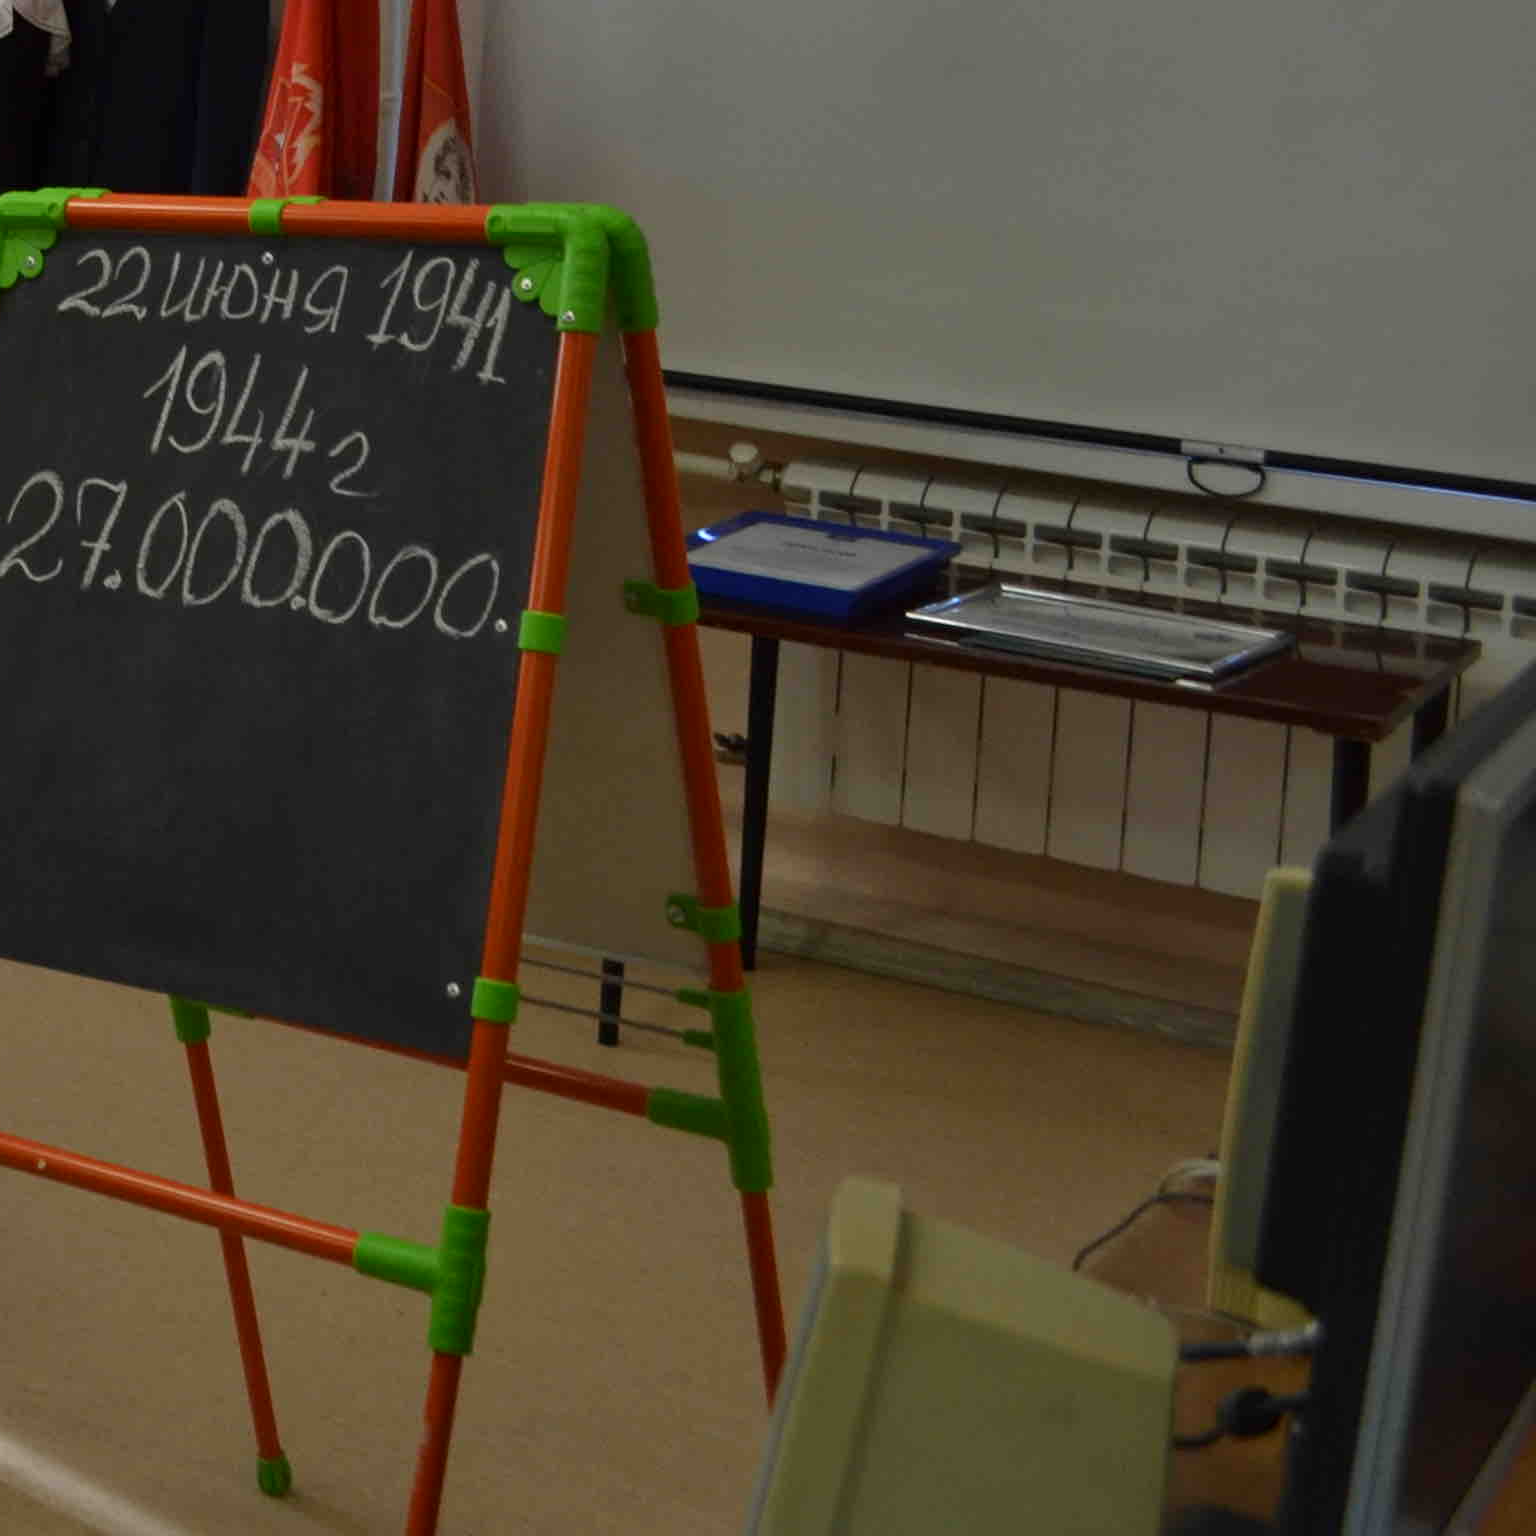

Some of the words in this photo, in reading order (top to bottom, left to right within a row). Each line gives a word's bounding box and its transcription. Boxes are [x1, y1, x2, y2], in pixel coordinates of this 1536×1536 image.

[58, 246, 152, 321] 22
[365, 249, 512, 385] 1941
[143, 345, 317, 478] 1944
